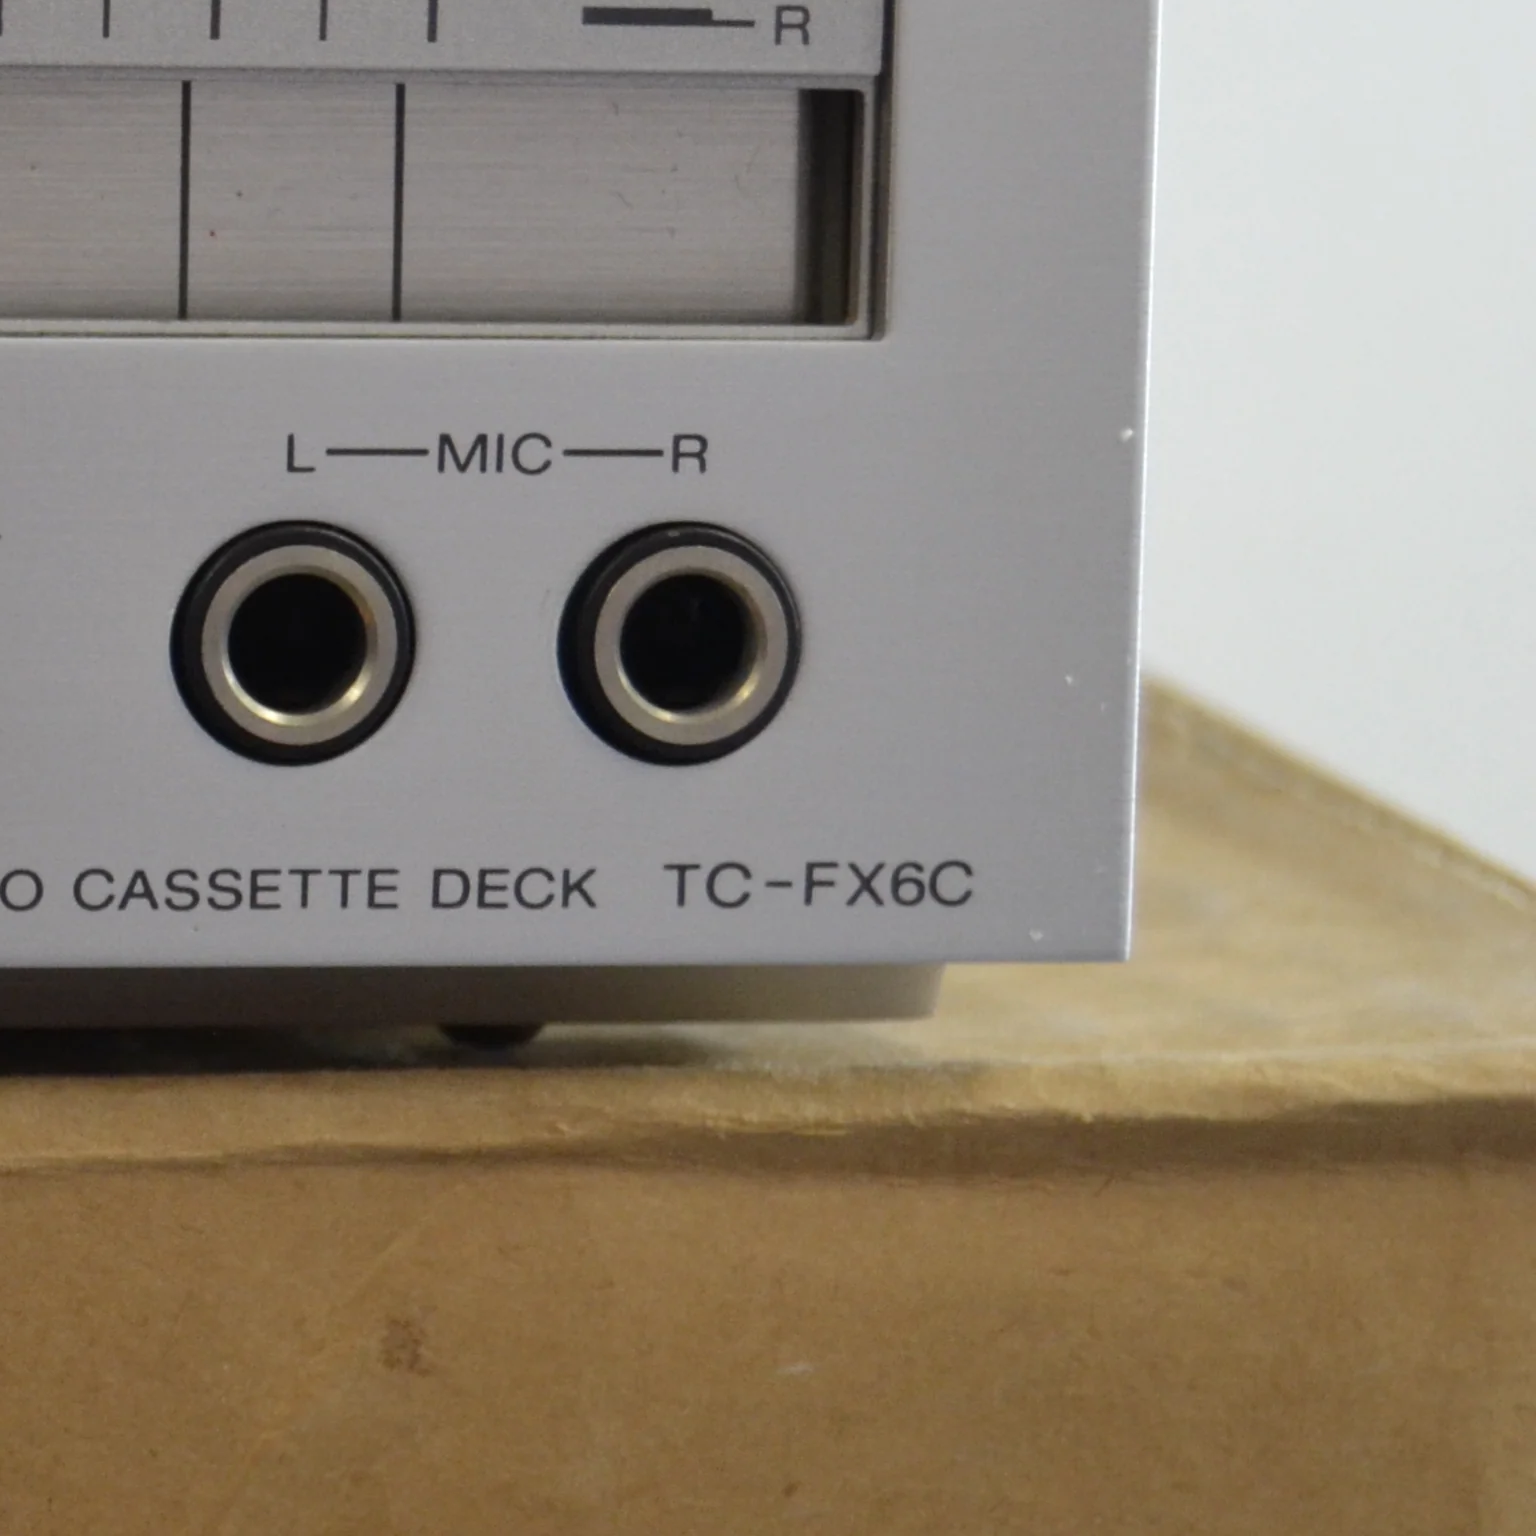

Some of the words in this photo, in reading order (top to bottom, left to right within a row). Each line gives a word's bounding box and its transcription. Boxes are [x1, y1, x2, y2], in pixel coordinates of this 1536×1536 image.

[774, 4, 811, 46] R
[286, 433, 316, 474] L
[437, 432, 553, 476] MIC
[671, 433, 709, 474] R
[72, 867, 399, 912] CASSETTE
[431, 866, 597, 910] DECK
[663, 859, 974, 909] TC-FX6C
